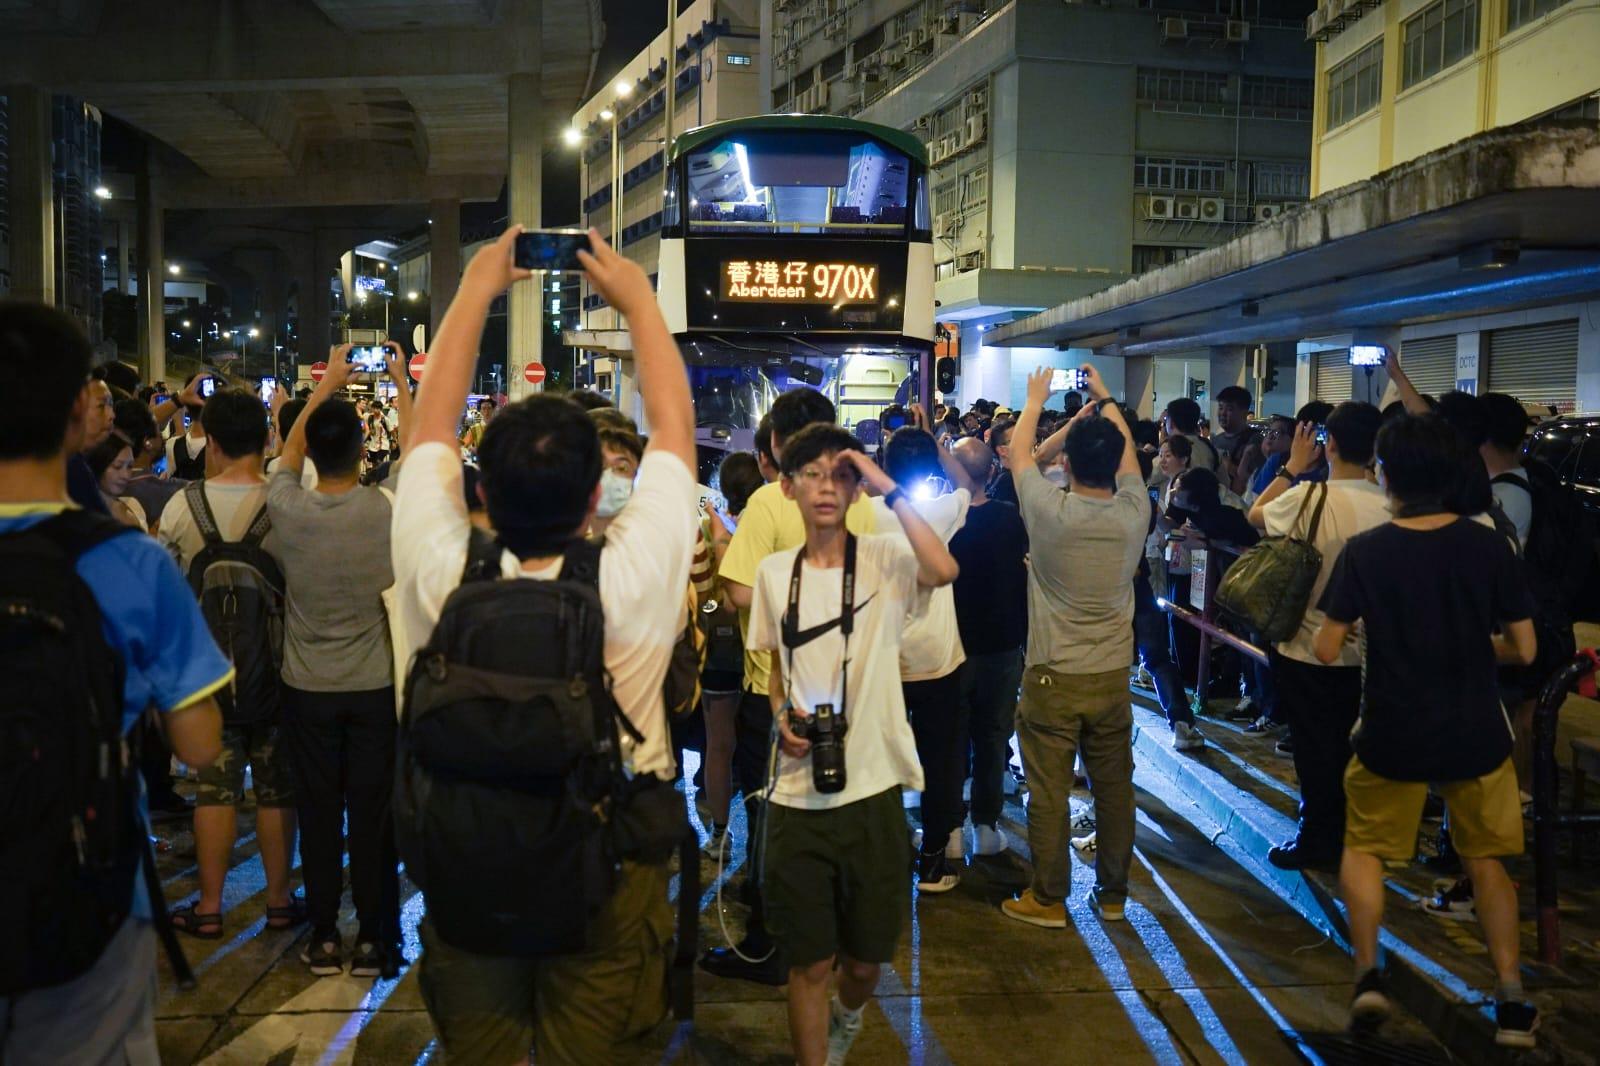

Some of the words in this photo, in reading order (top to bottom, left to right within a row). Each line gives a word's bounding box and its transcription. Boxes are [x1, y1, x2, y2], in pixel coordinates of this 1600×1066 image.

[727, 261, 808, 284] 香港仔
[813, 264, 875, 299] 970X
[728, 283, 806, 298] Aberdeen
